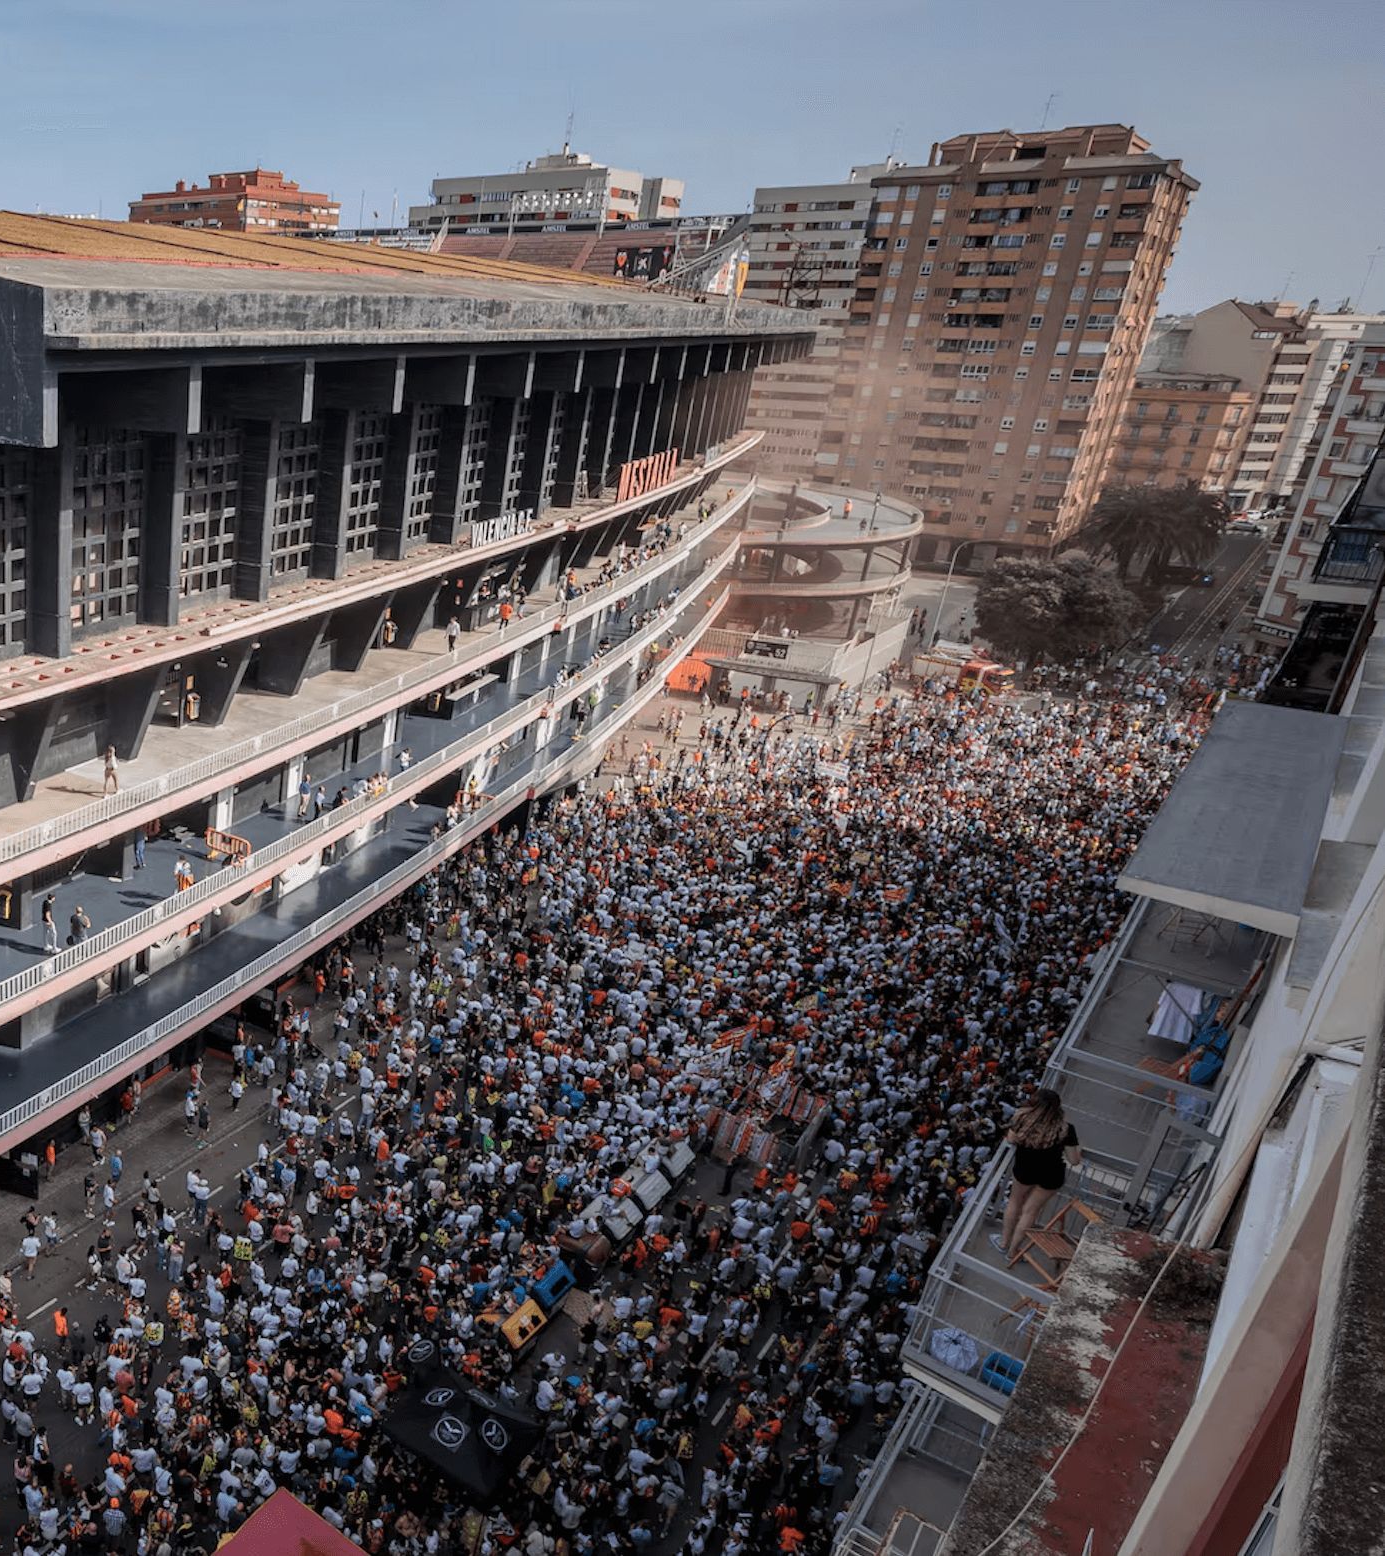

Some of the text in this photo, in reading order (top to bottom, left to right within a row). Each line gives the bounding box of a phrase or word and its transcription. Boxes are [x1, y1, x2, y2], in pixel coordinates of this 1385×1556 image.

[466, 227, 490, 235] AMSTEL
[541, 225, 566, 233] AMSTEL
[625, 223, 649, 231] AMSTEL
[616, 447, 678, 503] MESTALLA
[471, 512, 516, 549] VALENCIA
